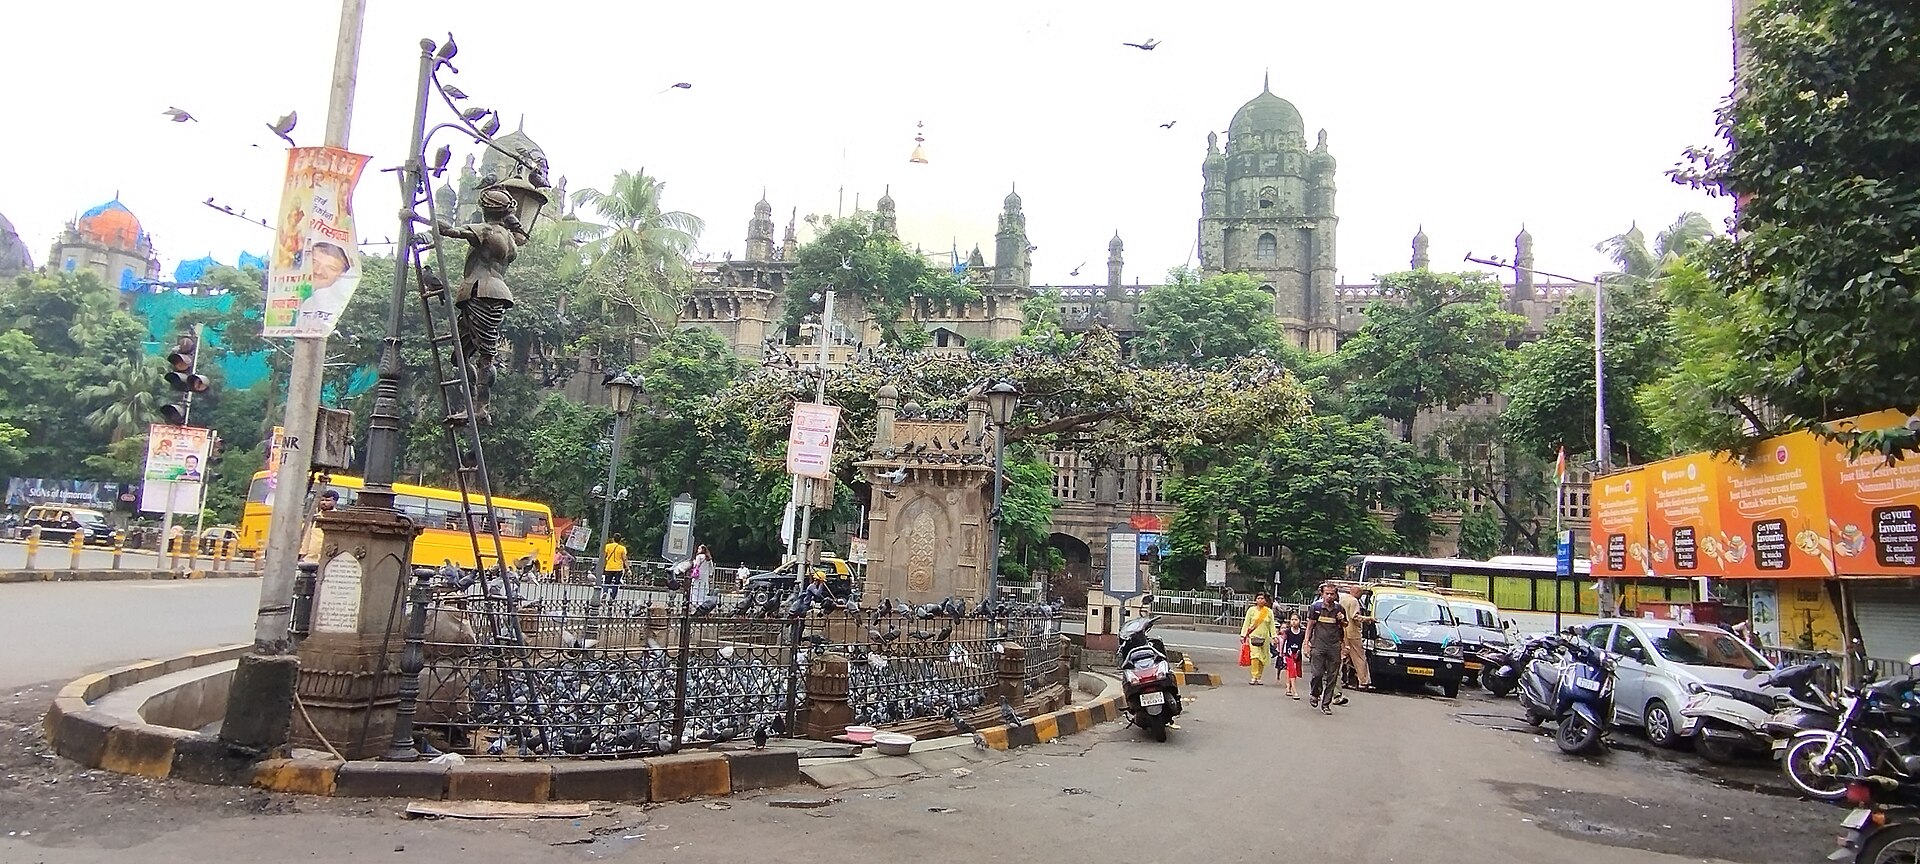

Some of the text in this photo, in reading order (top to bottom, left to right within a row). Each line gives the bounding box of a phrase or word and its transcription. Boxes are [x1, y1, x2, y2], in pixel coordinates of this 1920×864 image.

[1880, 510, 1912, 522] Get your
[1879, 521, 1917, 534] favourite
